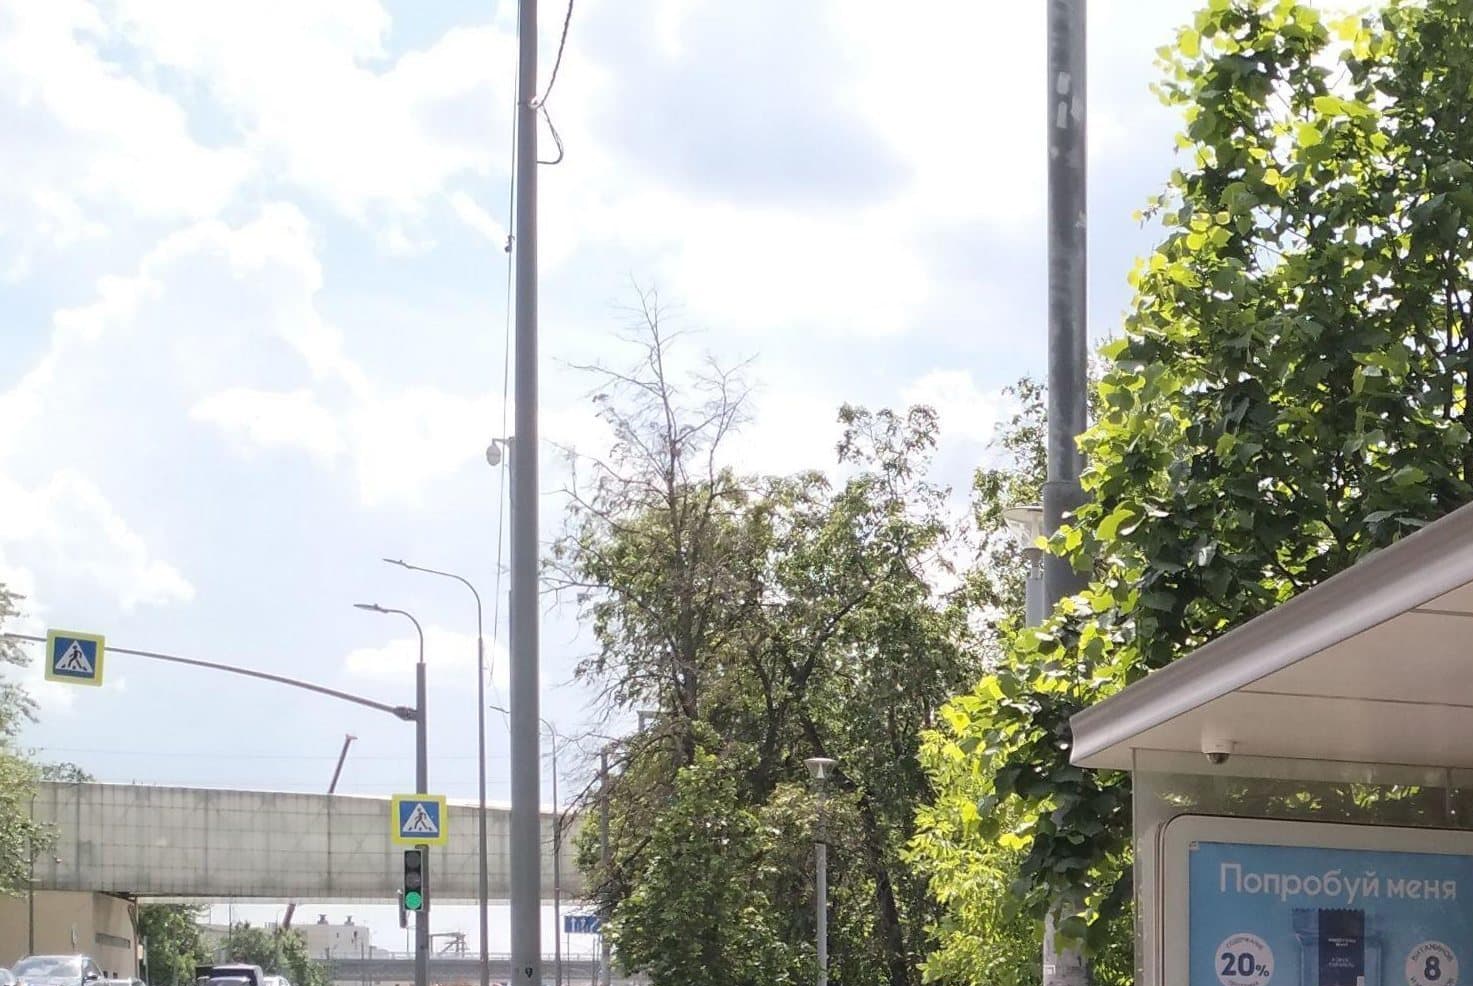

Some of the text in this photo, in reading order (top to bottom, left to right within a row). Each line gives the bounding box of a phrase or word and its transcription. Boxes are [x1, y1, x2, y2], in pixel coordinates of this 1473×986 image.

[1220, 862, 1457, 905] Попробуй меня
[1221, 952, 1270, 977] 20%
[1424, 956, 1441, 981] 8
